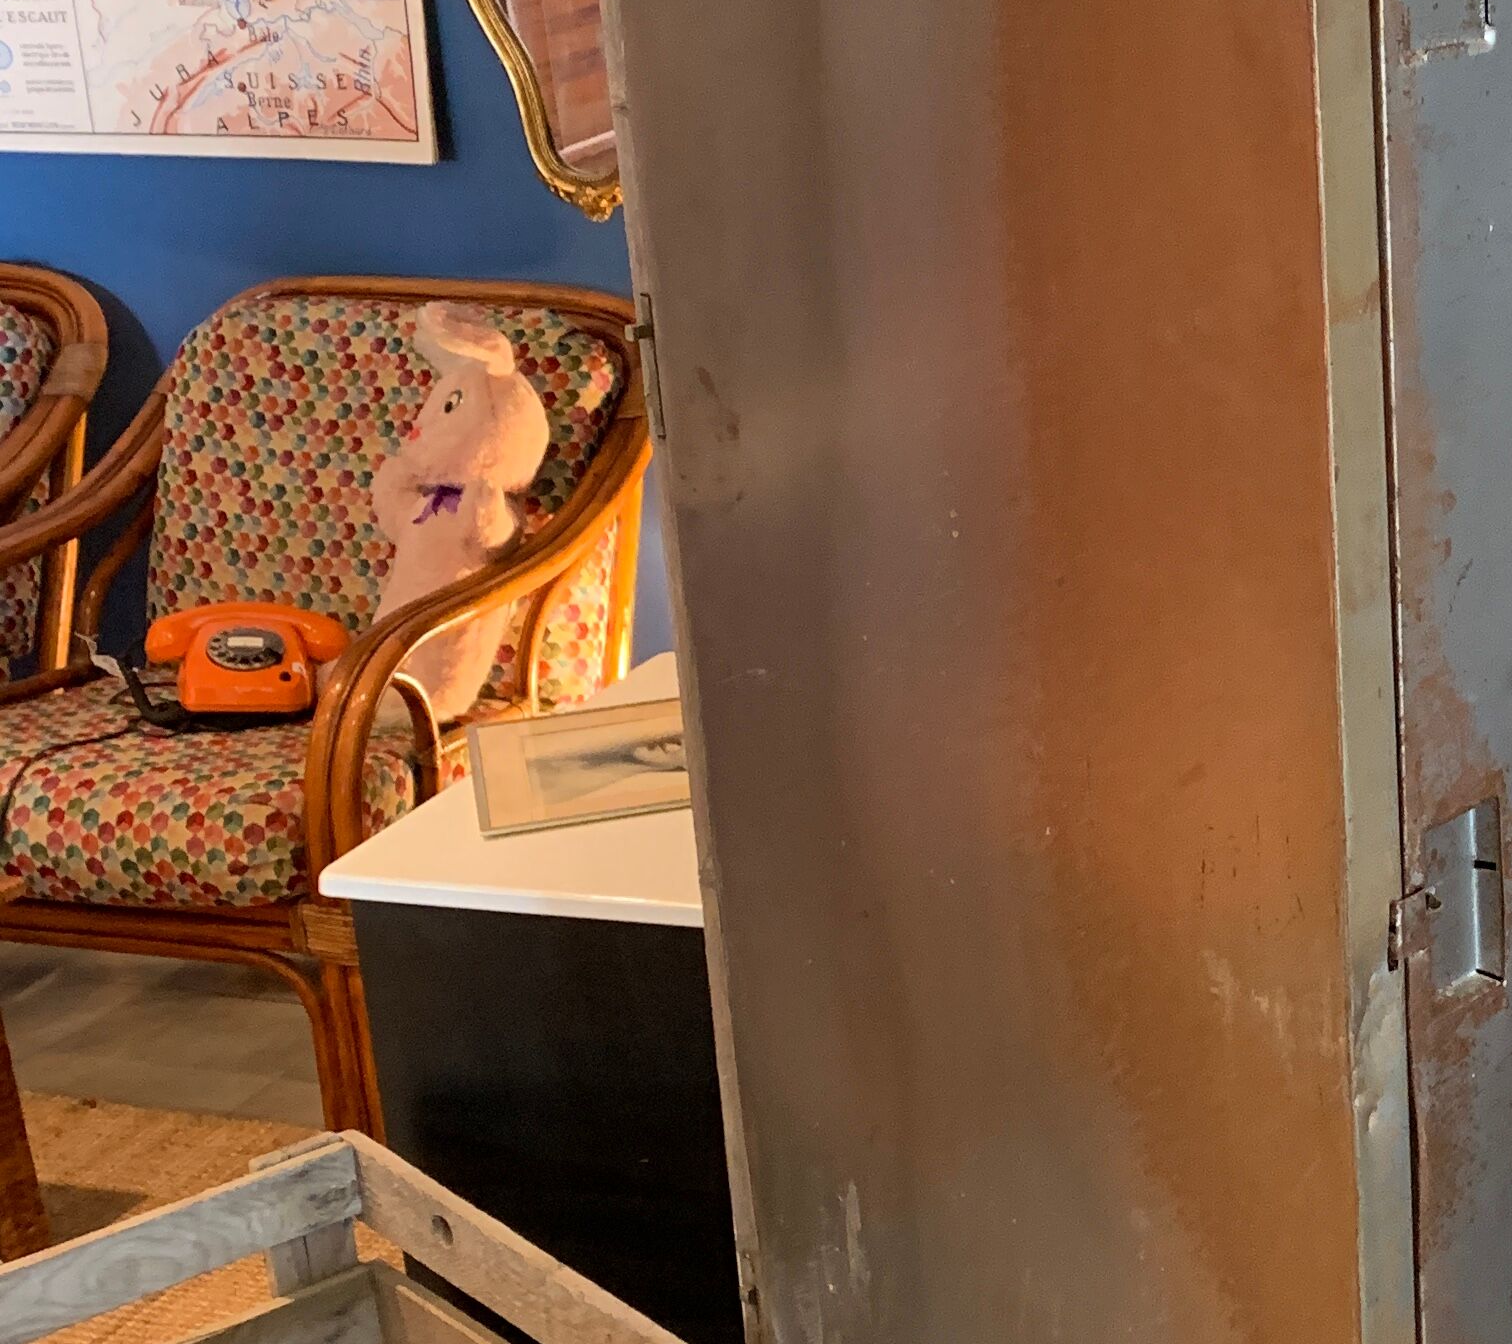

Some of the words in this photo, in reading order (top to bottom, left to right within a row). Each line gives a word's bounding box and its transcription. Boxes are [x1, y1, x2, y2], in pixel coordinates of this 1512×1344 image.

[223, 71, 348, 91] SUISSE
[247, 90, 293, 109] Berne
[217, 108, 349, 133] ALPES
